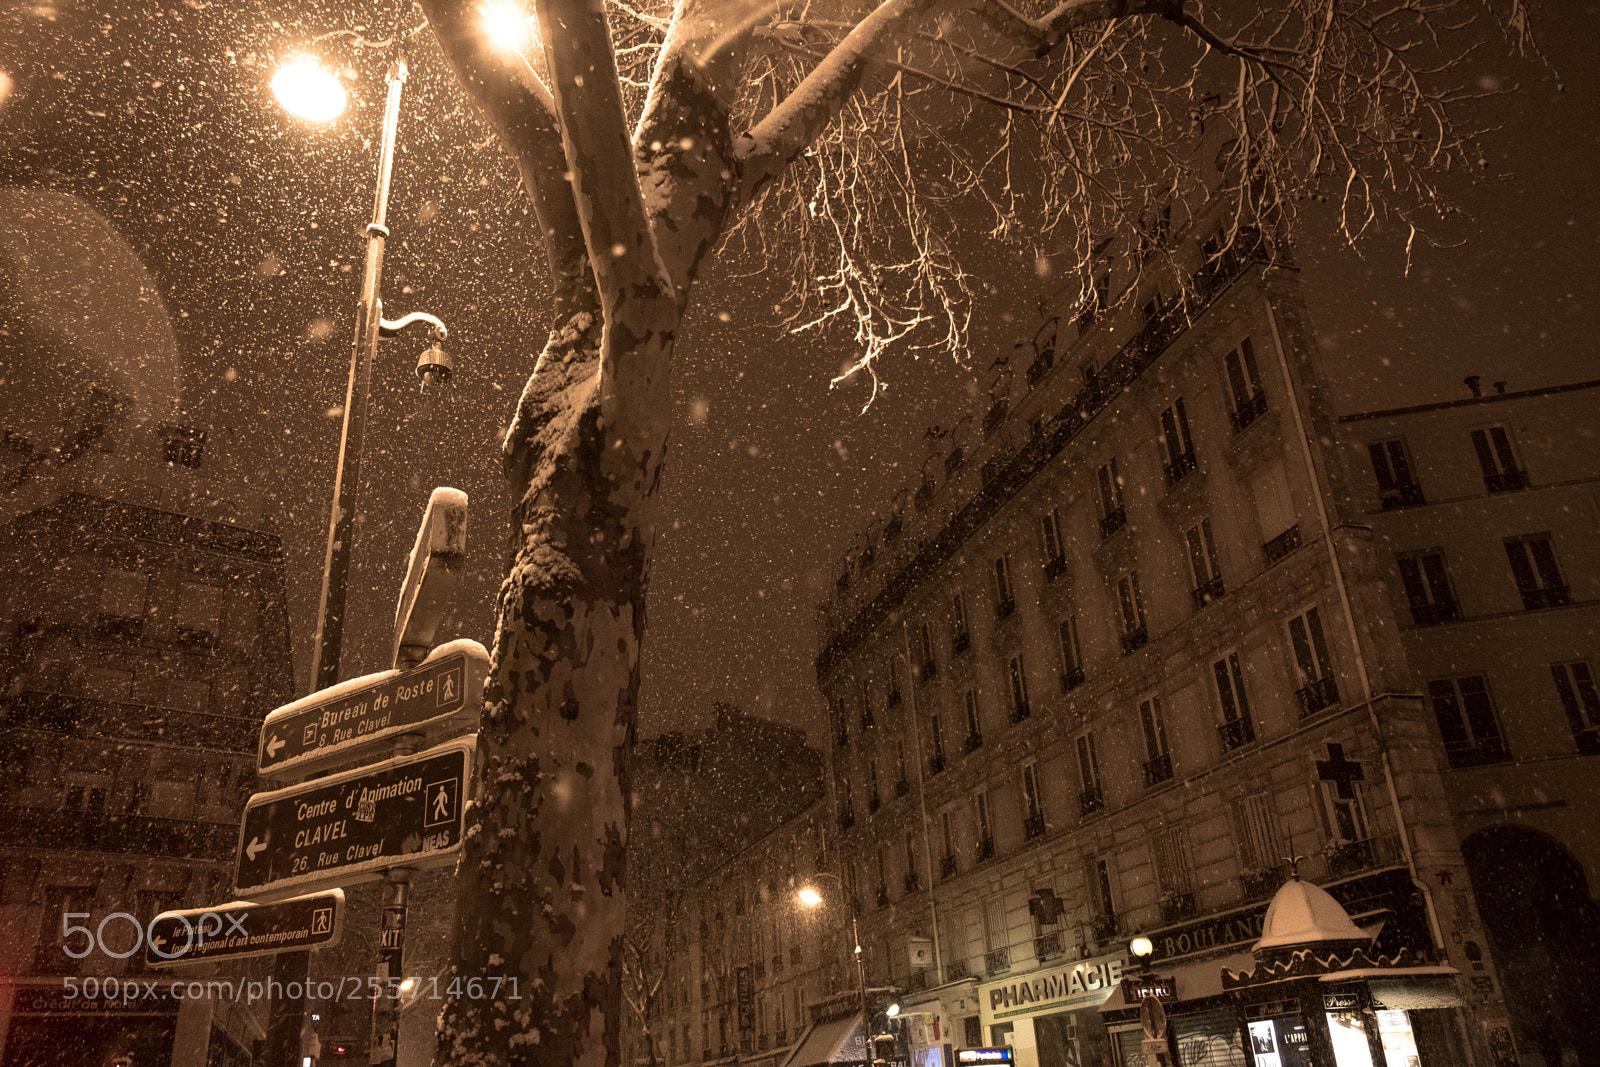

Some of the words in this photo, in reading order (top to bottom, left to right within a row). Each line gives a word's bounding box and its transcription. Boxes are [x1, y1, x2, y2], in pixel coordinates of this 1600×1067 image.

[321, 702, 368, 728] Bureau
[374, 693, 389, 711] de
[333, 728, 353, 743] Rue
[357, 711, 392, 734] Clavel
[297, 798, 337, 821] Centre
[345, 777, 422, 809] d'Animation
[294, 820, 347, 849] CLAVEL
[317, 852, 339, 868] Rue
[346, 838, 384, 861] Clavel
[228, 936, 249, 947] d'art
[249, 927, 309, 945] contemporain
[989, 959, 1123, 1010] PHARMACIE
